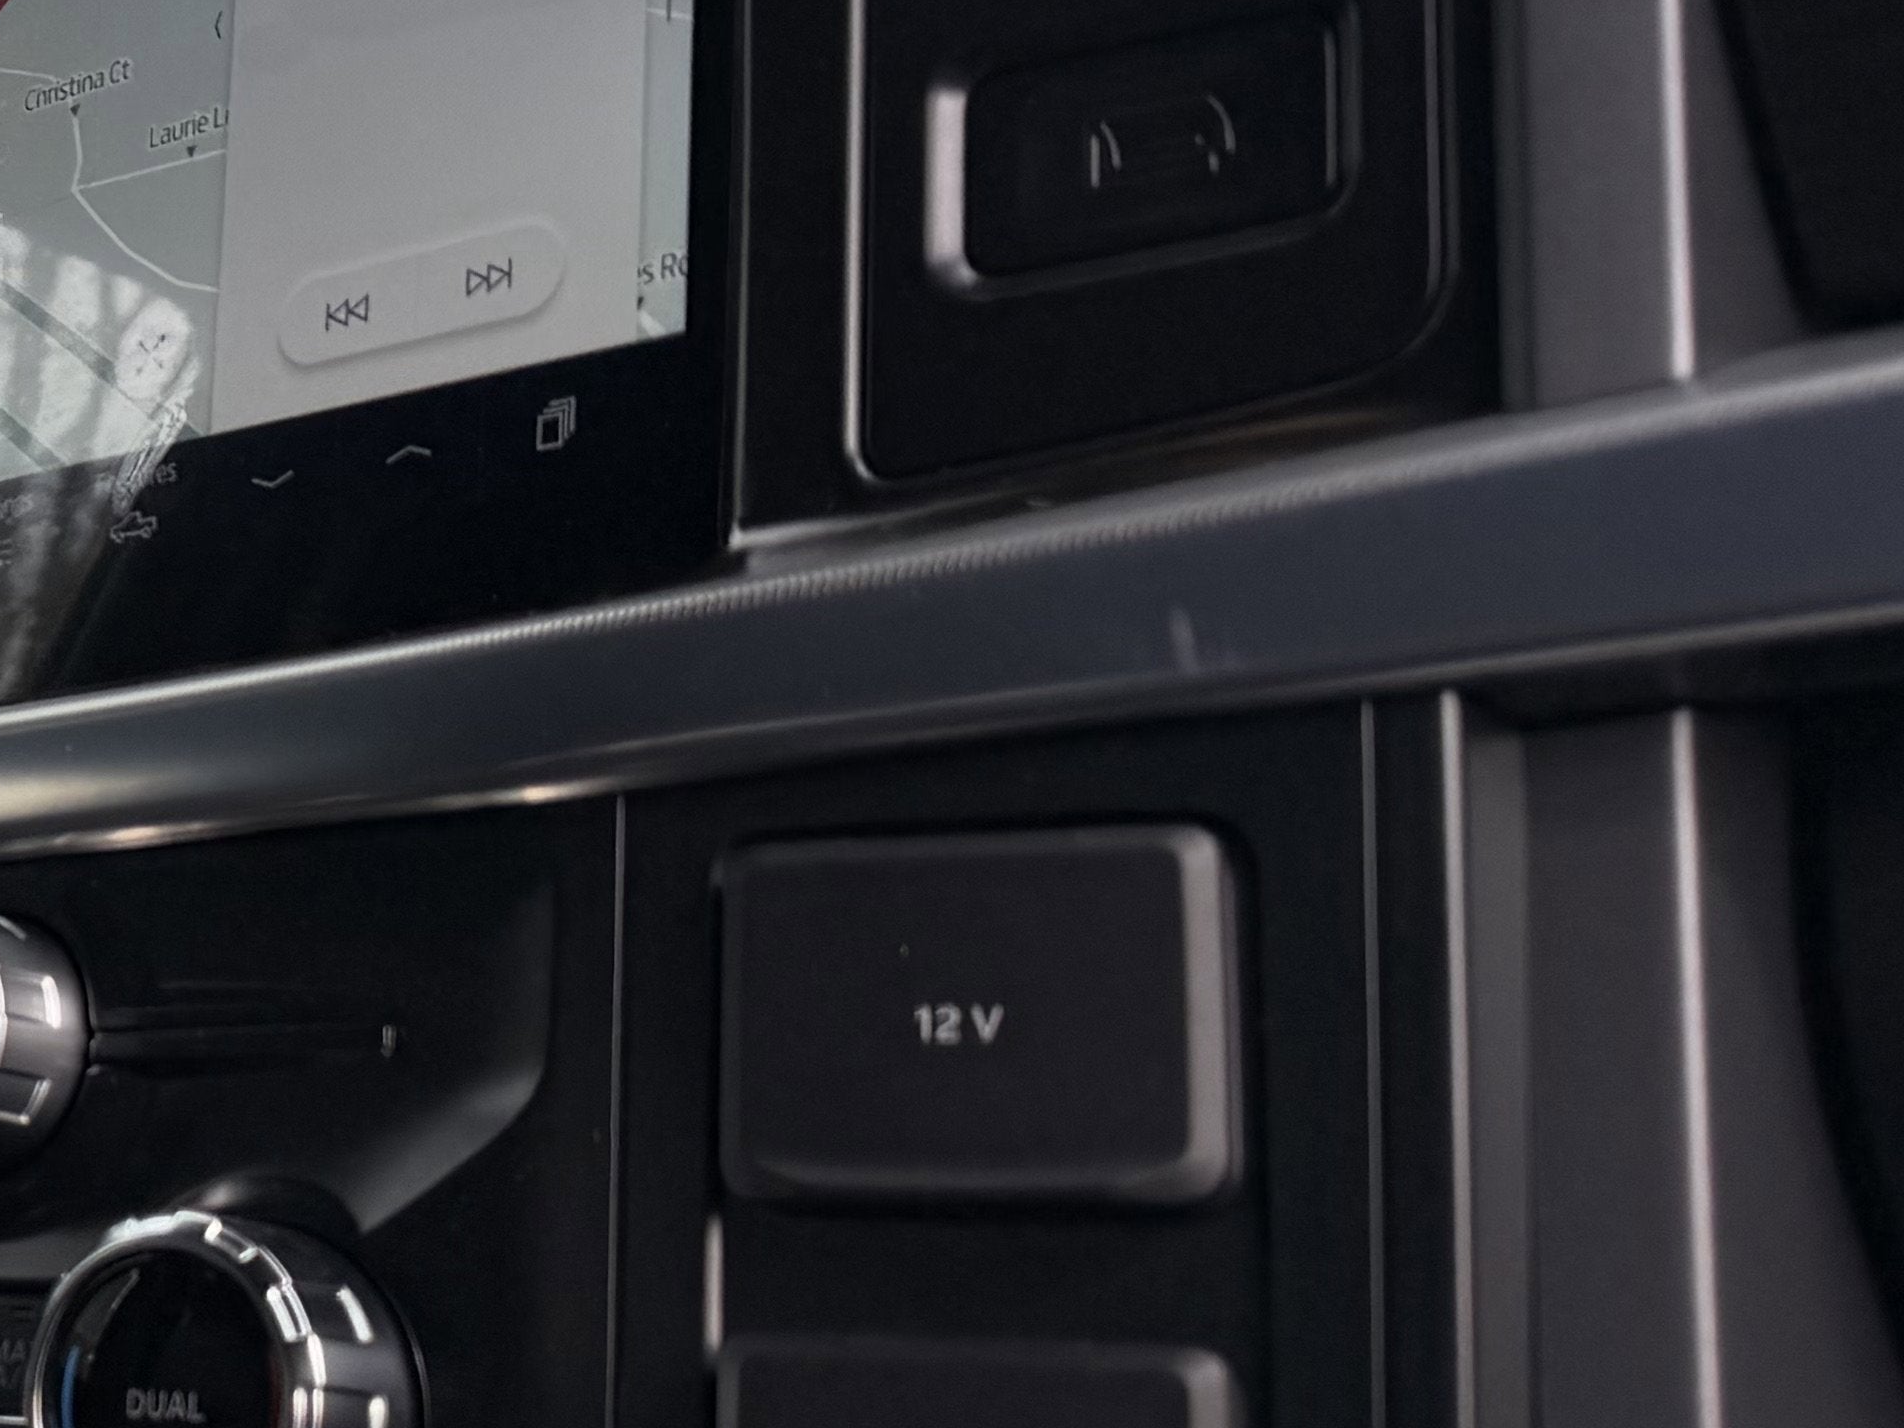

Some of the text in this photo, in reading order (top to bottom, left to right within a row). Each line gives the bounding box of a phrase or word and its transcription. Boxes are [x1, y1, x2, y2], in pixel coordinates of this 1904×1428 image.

[25, 58, 130, 113] Christina Ct
[149, 113, 210, 149] Laurie
[915, 1005, 1004, 1046] 12 V
[125, 1387, 206, 1422] DUAL
